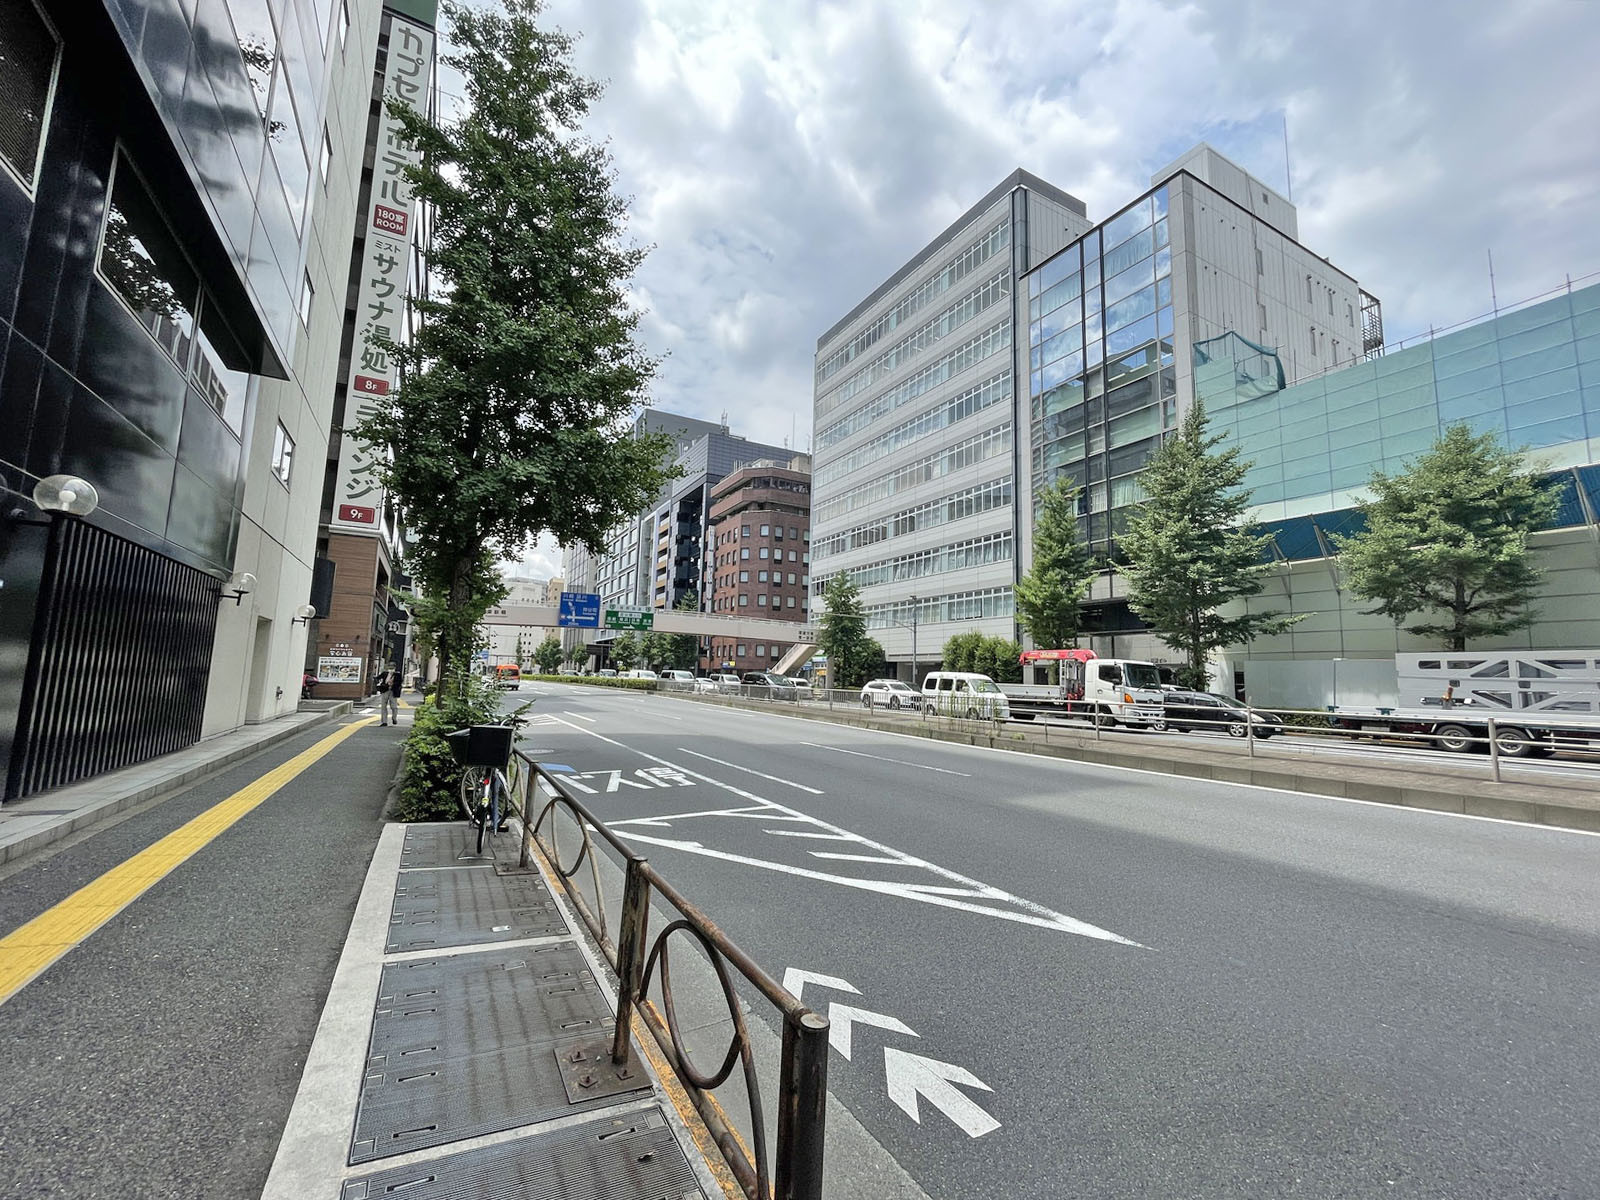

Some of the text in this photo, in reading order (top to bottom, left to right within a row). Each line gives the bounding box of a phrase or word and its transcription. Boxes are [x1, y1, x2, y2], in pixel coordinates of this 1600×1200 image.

[380, 27, 424, 208] カプセホテル
[377, 208, 405, 224] 180室
[376, 218, 404, 232] ROOM
[374, 239, 401, 254] ミスト
[360, 253, 399, 375] サウナ湯処
[364, 379, 378, 391] 8F
[350, 508, 364, 520] 9F
